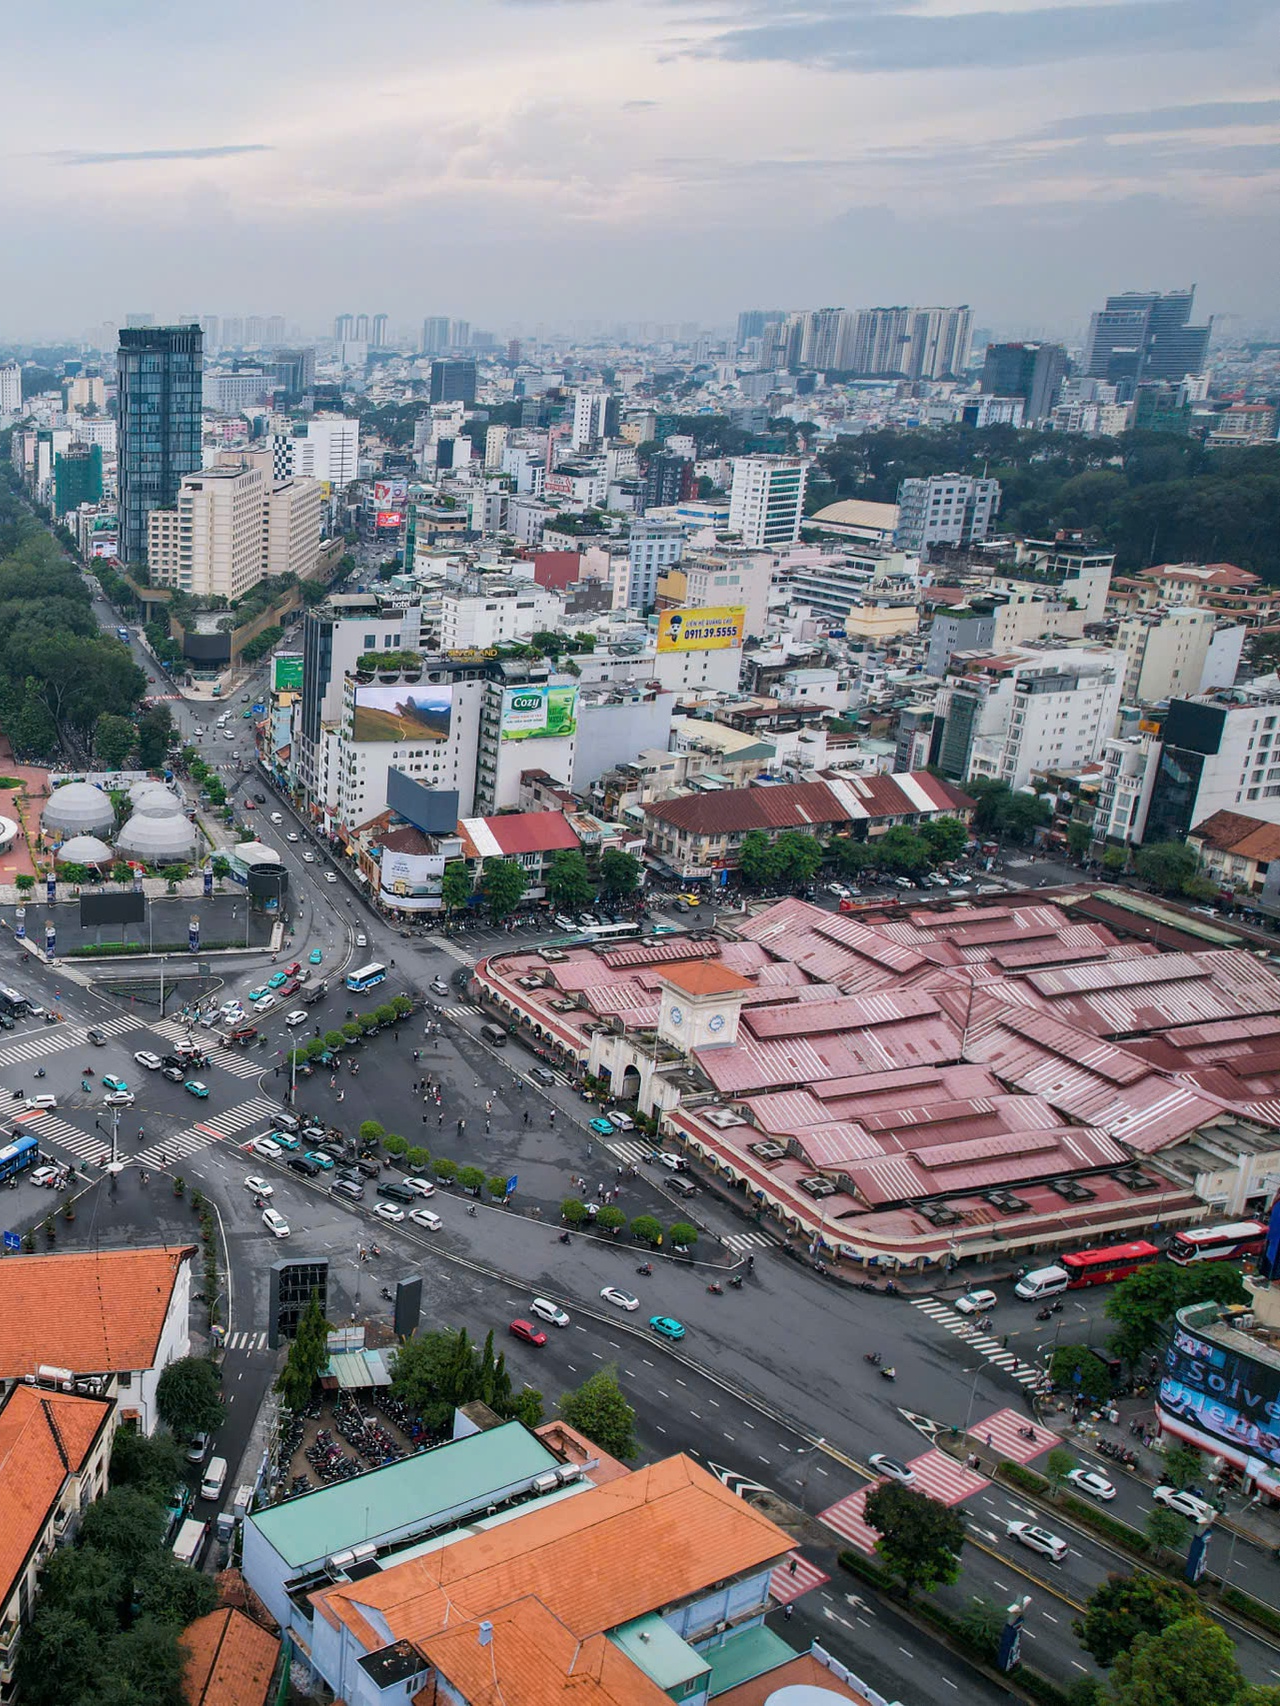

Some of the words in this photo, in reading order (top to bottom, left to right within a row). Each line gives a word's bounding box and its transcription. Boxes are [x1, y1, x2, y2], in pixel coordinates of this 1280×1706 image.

[684, 627, 737, 639] 0911.39.5555
[514, 697, 540, 709] Cozy
[1187, 1358, 1280, 1419] Solve
